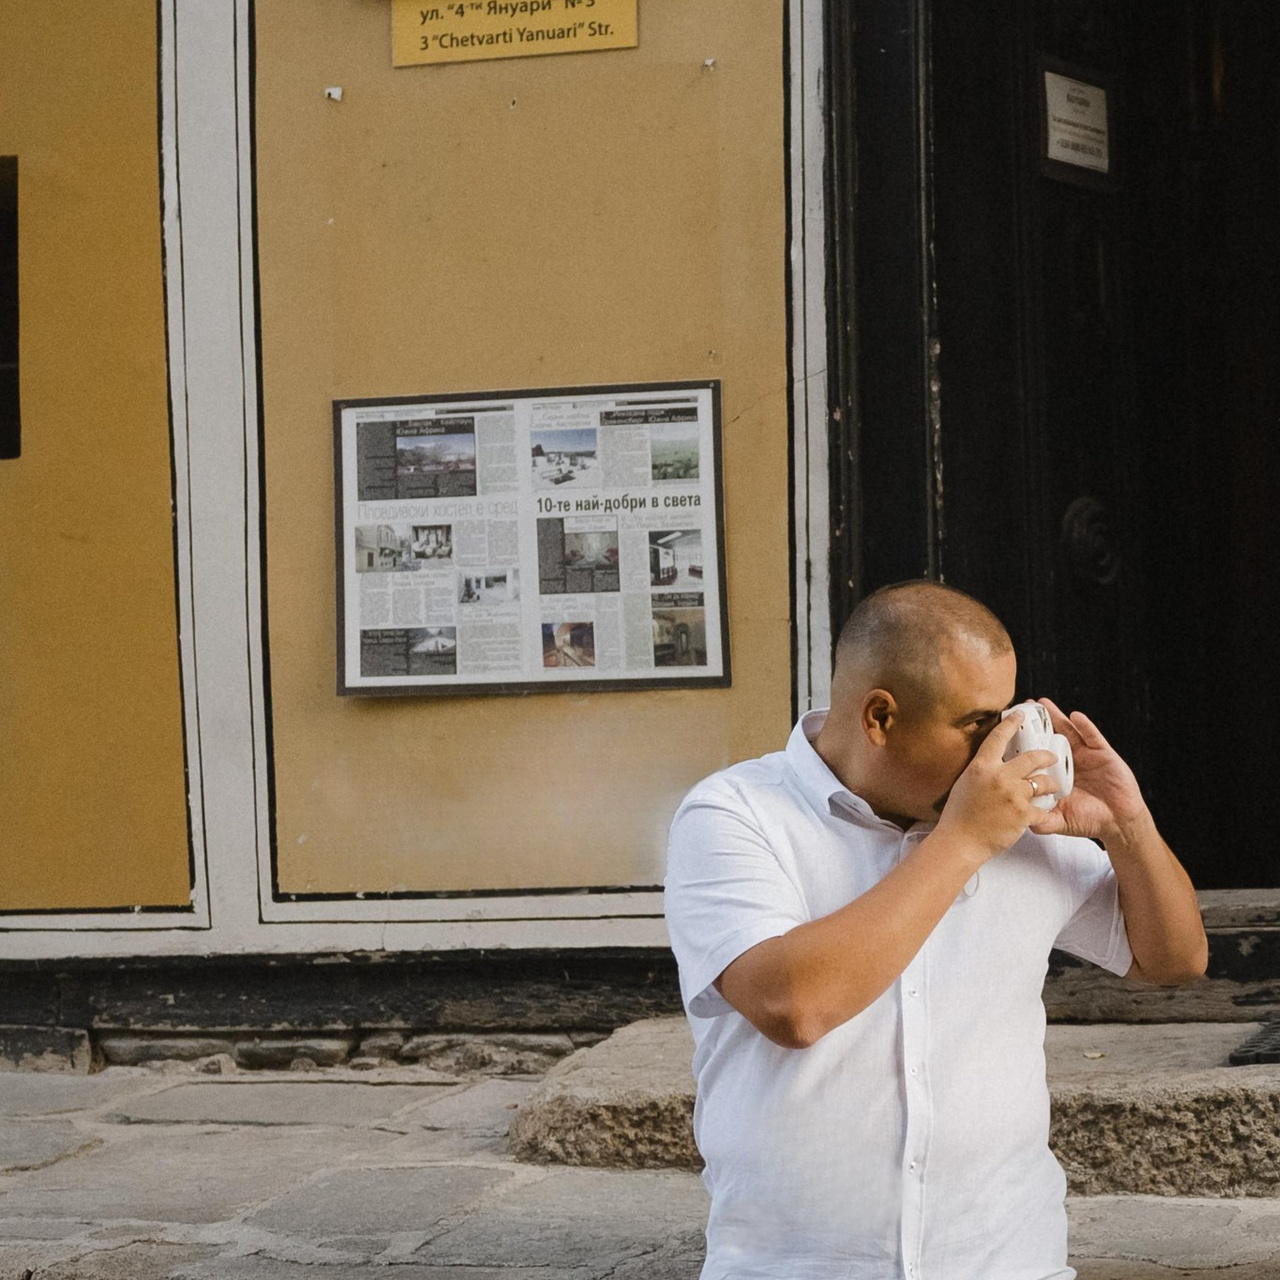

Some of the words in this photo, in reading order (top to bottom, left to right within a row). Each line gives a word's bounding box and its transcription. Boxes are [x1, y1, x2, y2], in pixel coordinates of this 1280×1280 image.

[420, 9, 444, 25] ул.
[420, 36, 428, 51] 3
[588, 21, 614, 36] Str.
[537, 497, 571, 513] 10-те
[575, 493, 647, 514] най-добри
[652, 497, 659, 507] в
[663, 494, 701, 507] света
